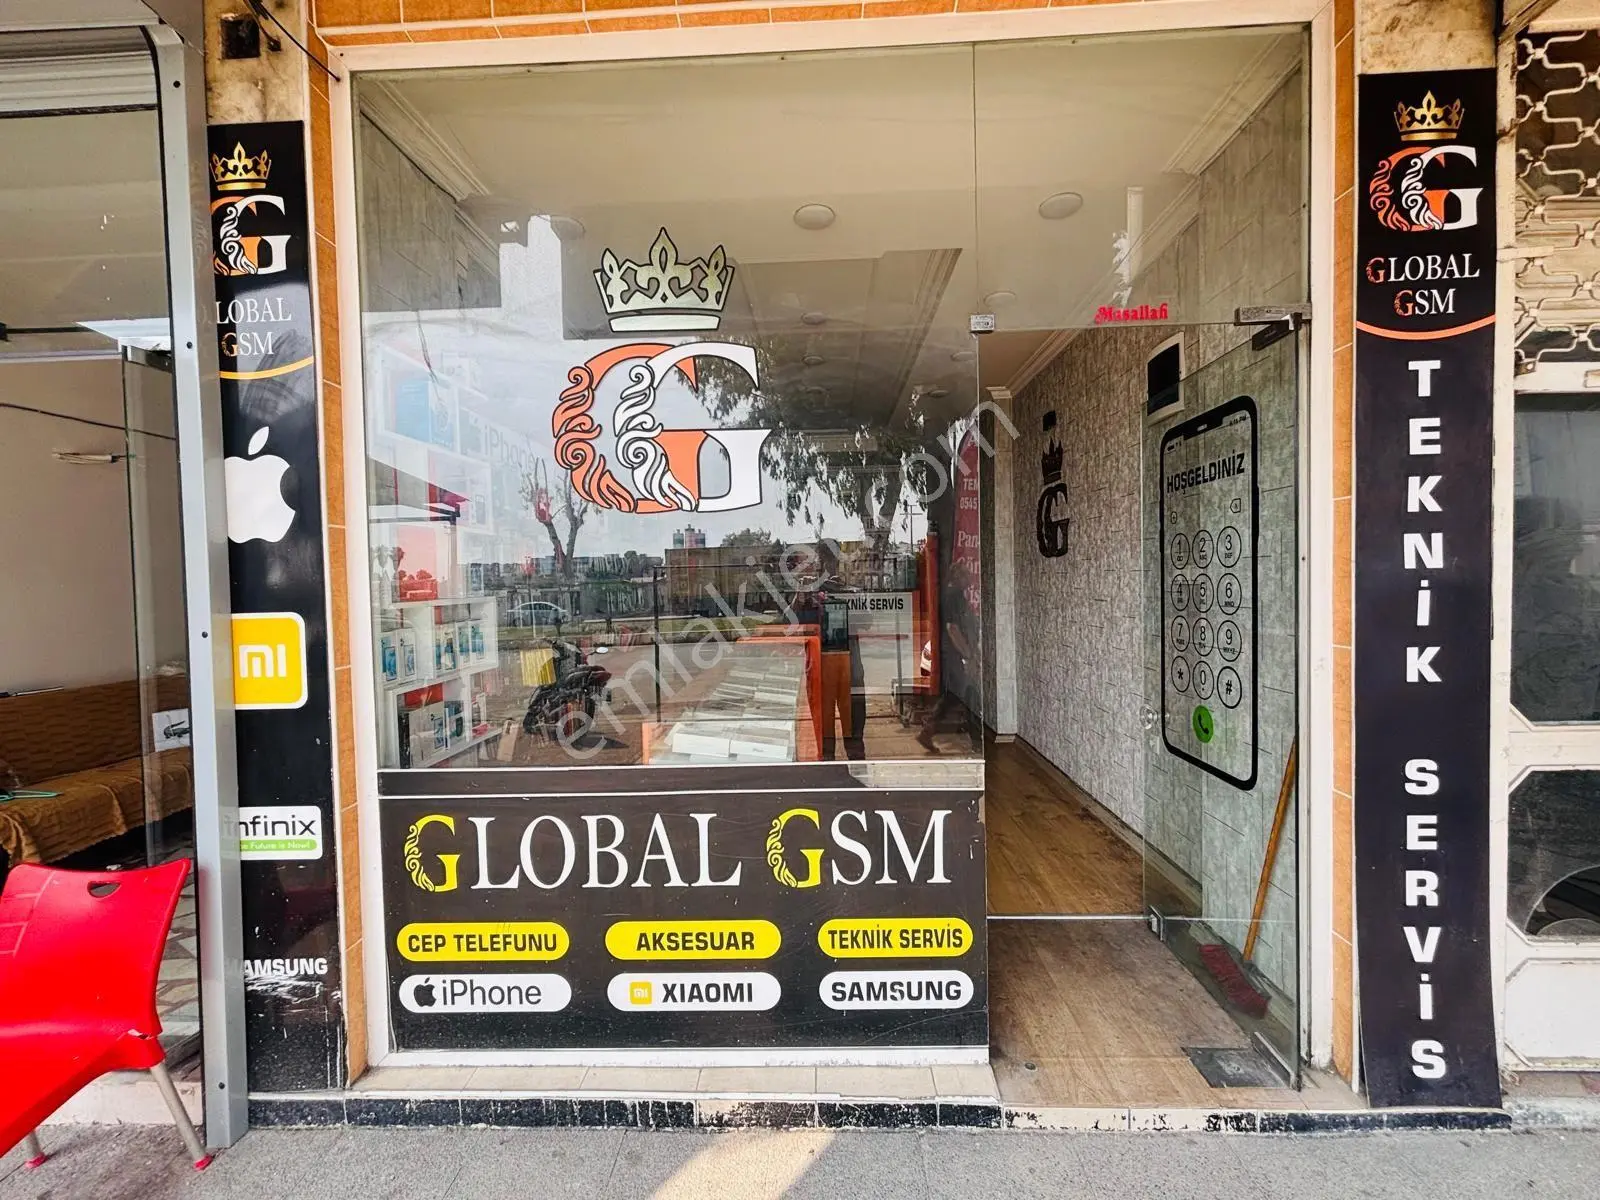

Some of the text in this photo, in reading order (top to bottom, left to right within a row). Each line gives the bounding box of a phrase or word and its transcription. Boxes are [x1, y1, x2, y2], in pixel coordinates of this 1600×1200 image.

[1366, 253, 1480, 284] GLOBAL
[216, 297, 292, 325] LOBAL
[1393, 288, 1456, 316] GSM
[221, 331, 275, 358] GSM
[1166, 449, 1245, 495] HOŞGELDİNİZ
[1403, 359, 1444, 683] TEKNİK
[1199, 537, 1206, 552] 2
[1225, 534, 1232, 550] 3
[1225, 582, 1233, 598] 6
[869, 596, 904, 610] SERVİS
[1200, 626, 1206, 641] 8
[1225, 629, 1233, 645] 9
[239, 814, 317, 836] nfinix
[404, 808, 953, 893] GLOBAL GSM
[1403, 758, 1447, 1079] SERVİS
[407, 933, 558, 953] CEP TELEFUNU
[636, 932, 755, 951] AKSESUAR
[827, 922, 964, 950] TEKNİK SERVİS
[243, 957, 329, 976] AMSUNG
[442, 978, 542, 1006] iPhone
[662, 982, 754, 1004] XIAOMI
[831, 980, 962, 1002] SAMSUNG
